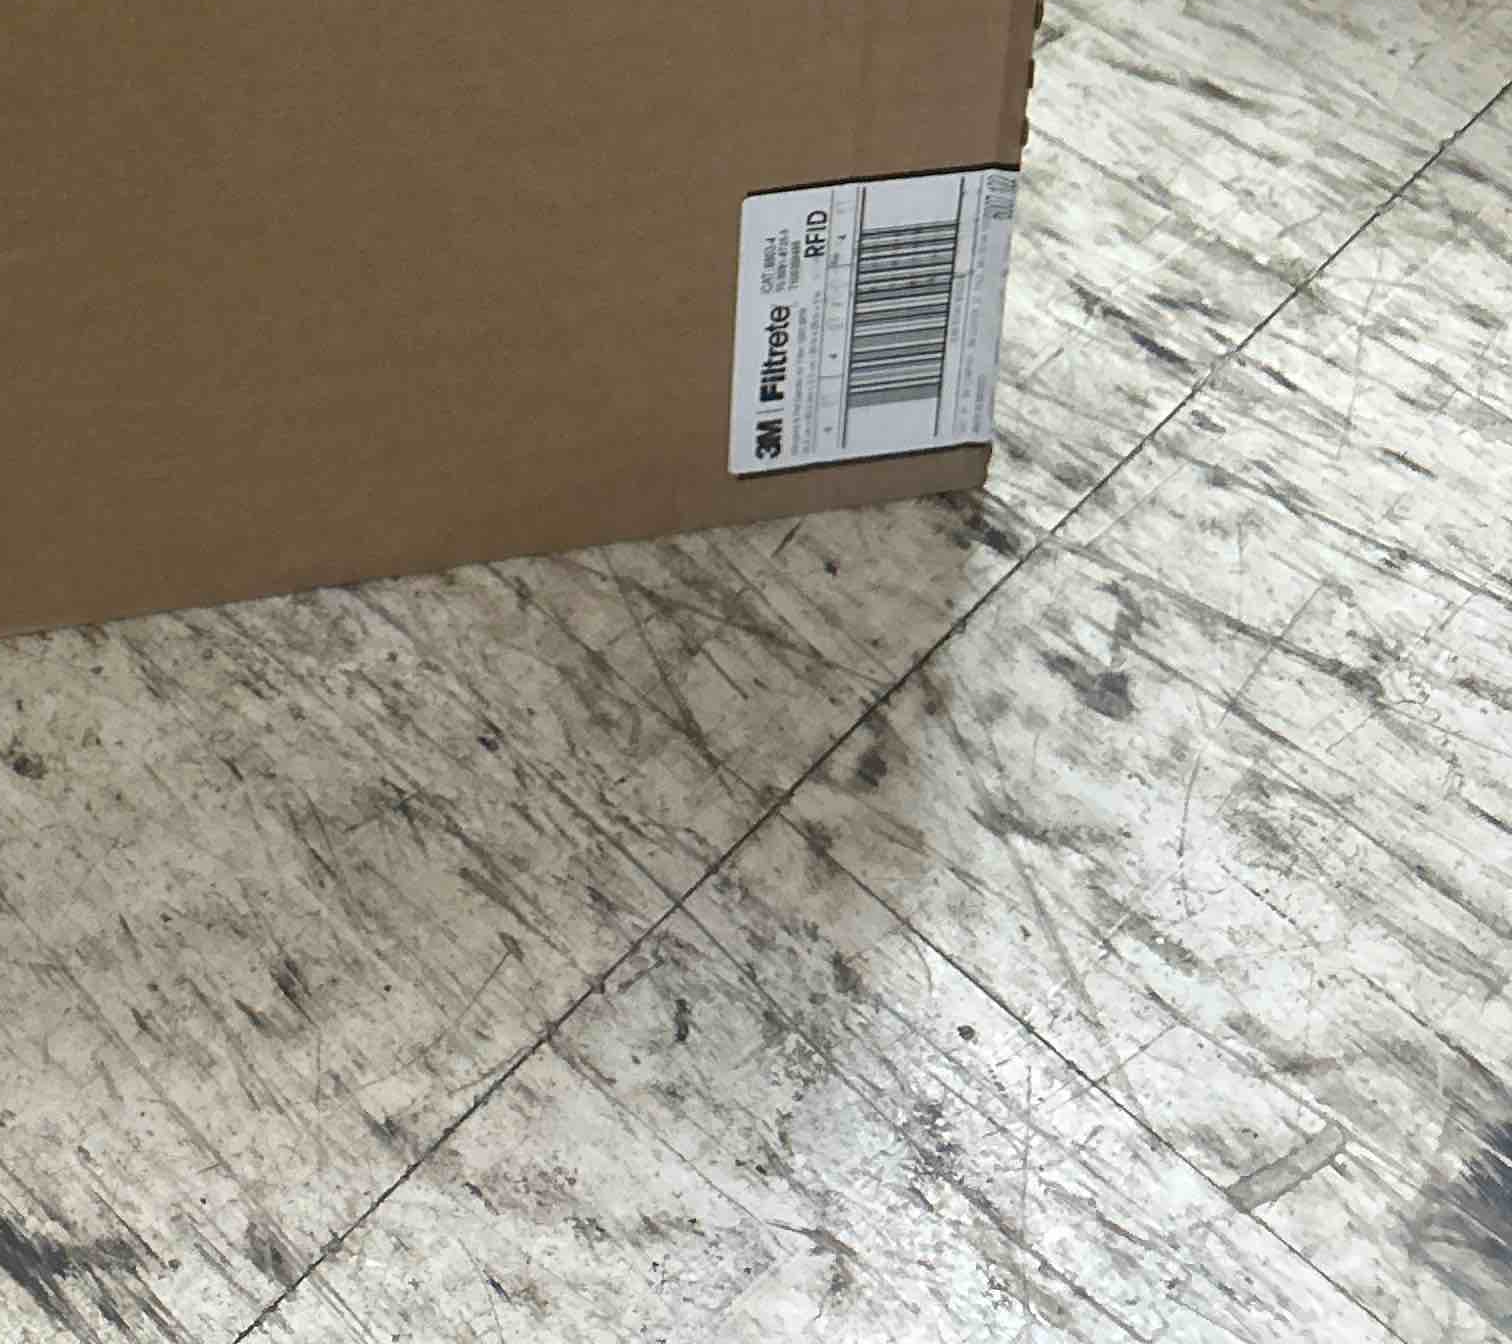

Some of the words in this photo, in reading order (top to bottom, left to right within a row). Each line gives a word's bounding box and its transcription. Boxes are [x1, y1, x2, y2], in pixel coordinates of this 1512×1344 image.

[804, 210, 827, 259] RFID
[760, 304, 792, 403] Filtrete
[755, 417, 785, 460] 3M
